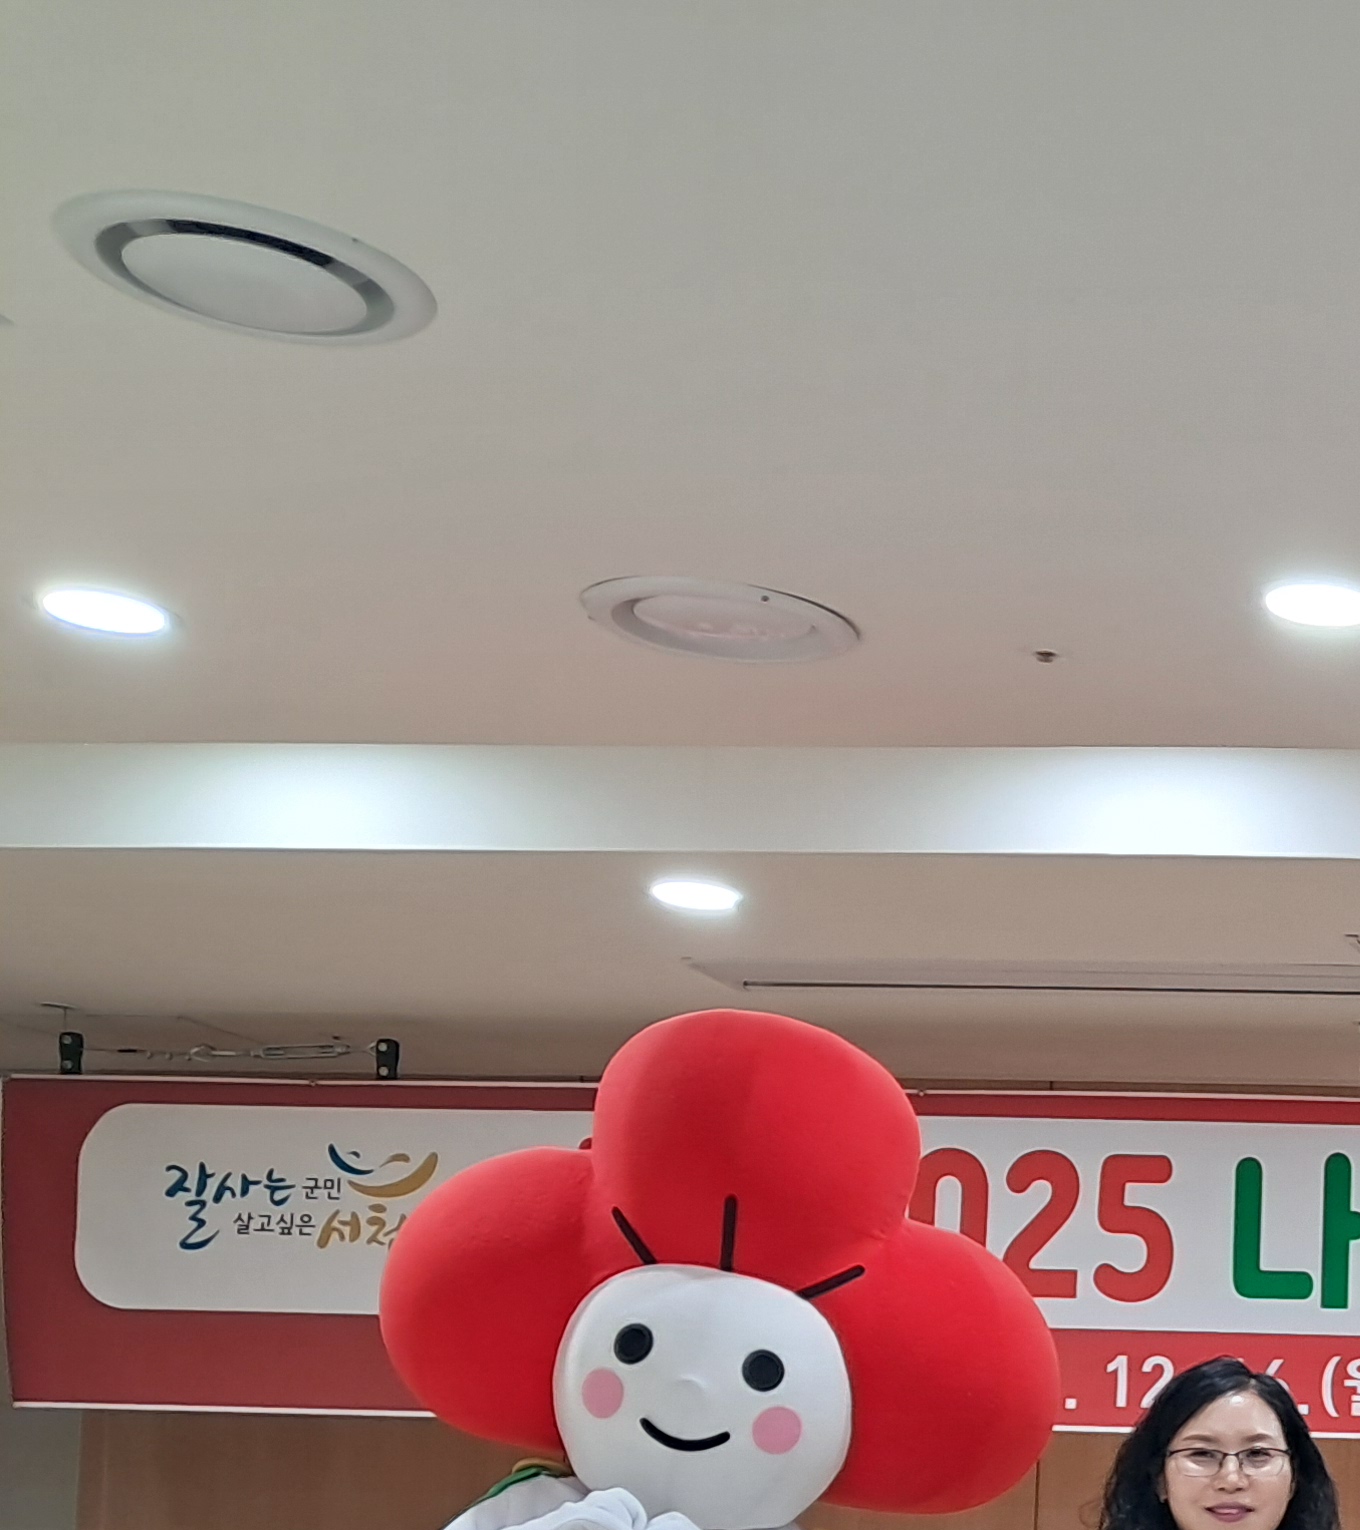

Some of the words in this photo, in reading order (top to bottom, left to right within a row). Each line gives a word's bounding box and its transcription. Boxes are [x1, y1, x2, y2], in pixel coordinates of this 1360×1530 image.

[164, 1161, 297, 1251] 잘사는
[301, 1177, 341, 1201] 군민
[232, 1212, 316, 1236] 살고싶은
[908, 1147, 1174, 1303] 025
[1106, 1355, 1174, 1408] 12
